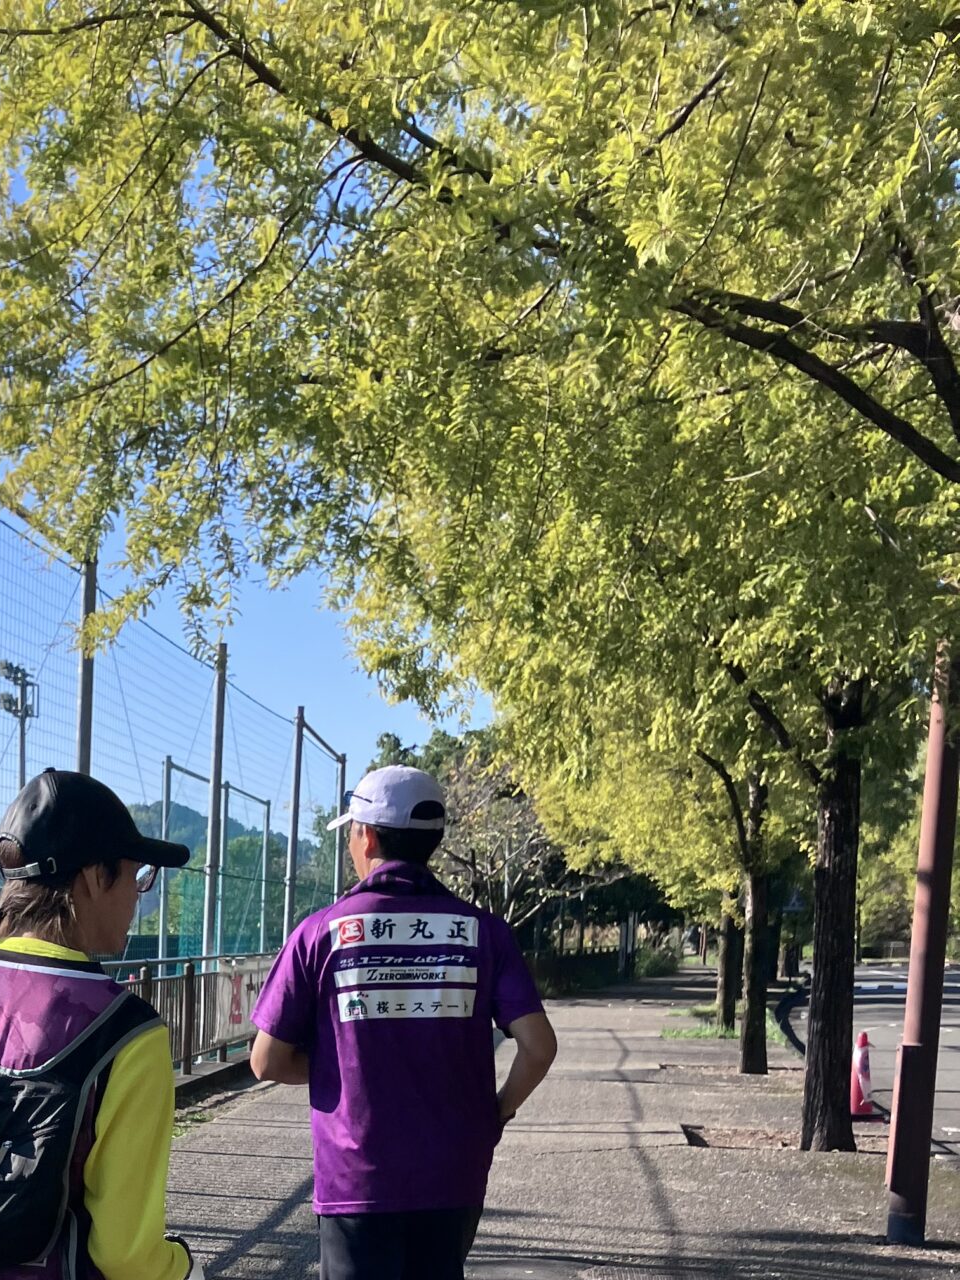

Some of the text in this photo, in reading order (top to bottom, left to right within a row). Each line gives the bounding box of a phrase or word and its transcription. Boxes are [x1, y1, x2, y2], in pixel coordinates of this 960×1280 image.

[370, 918, 469, 941] 新丸正
[357, 955, 470, 965] ユニフォームセンター
[376, 1001, 468, 1014] 桜エステート
